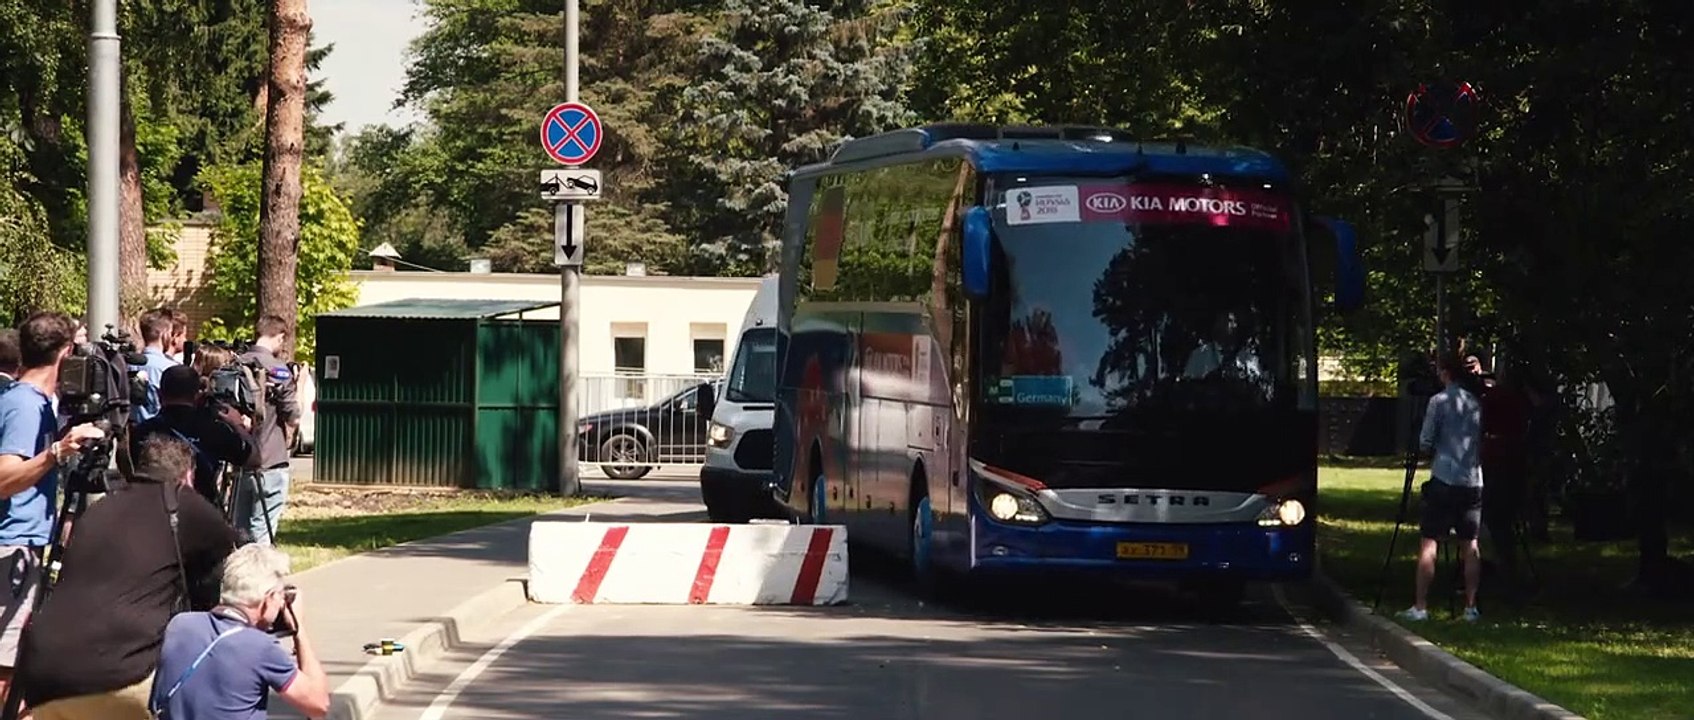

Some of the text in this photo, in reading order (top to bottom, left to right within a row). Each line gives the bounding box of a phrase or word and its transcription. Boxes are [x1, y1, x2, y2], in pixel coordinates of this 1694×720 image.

[1131, 196, 1246, 216] KIA MOTORS
[1017, 392, 1068, 407] Germany
[1098, 493, 1210, 507] SETRA
